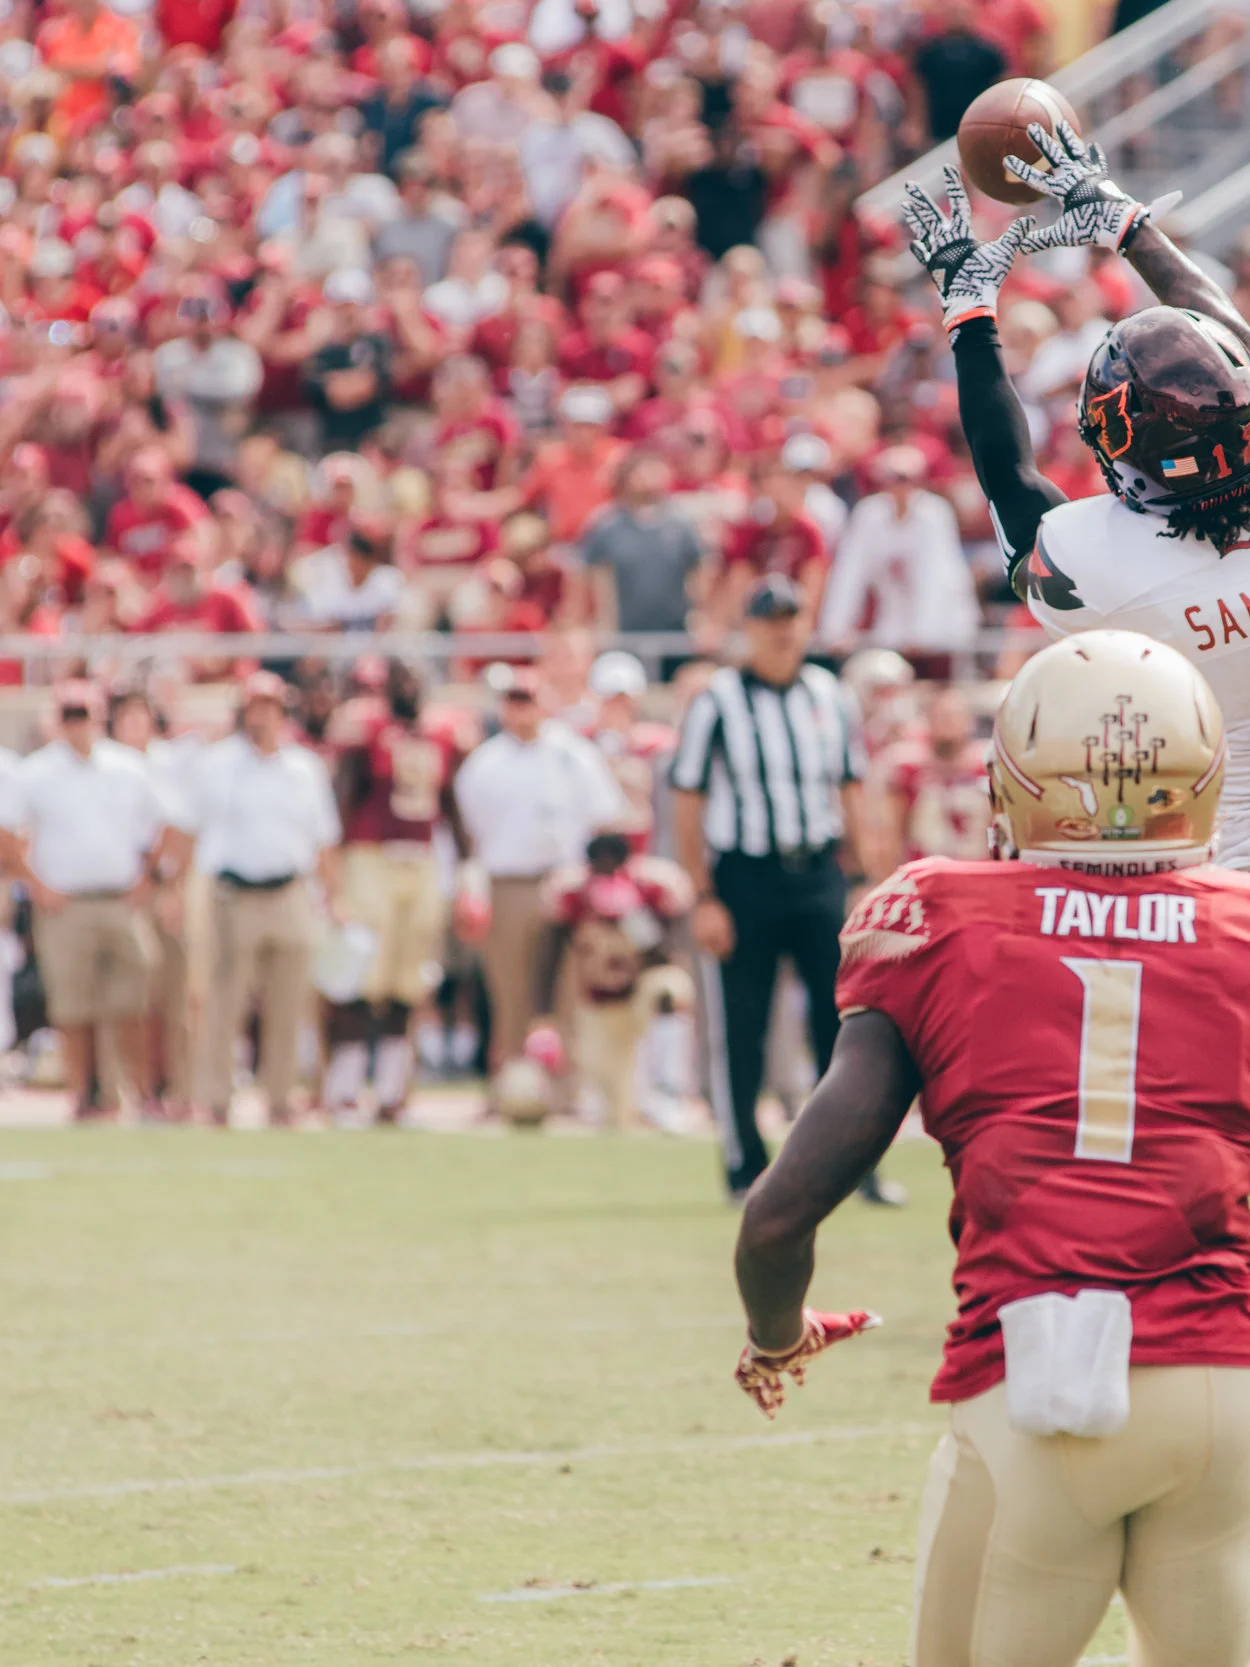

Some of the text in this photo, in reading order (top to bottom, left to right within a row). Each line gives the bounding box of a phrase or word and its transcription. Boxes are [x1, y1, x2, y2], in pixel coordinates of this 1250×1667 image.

[1211, 443, 1233, 479] 1
[1059, 858, 1178, 877] SEMINOLES
[1034, 886, 1198, 944] TAYLOR
[1059, 955, 1143, 1164] 1
